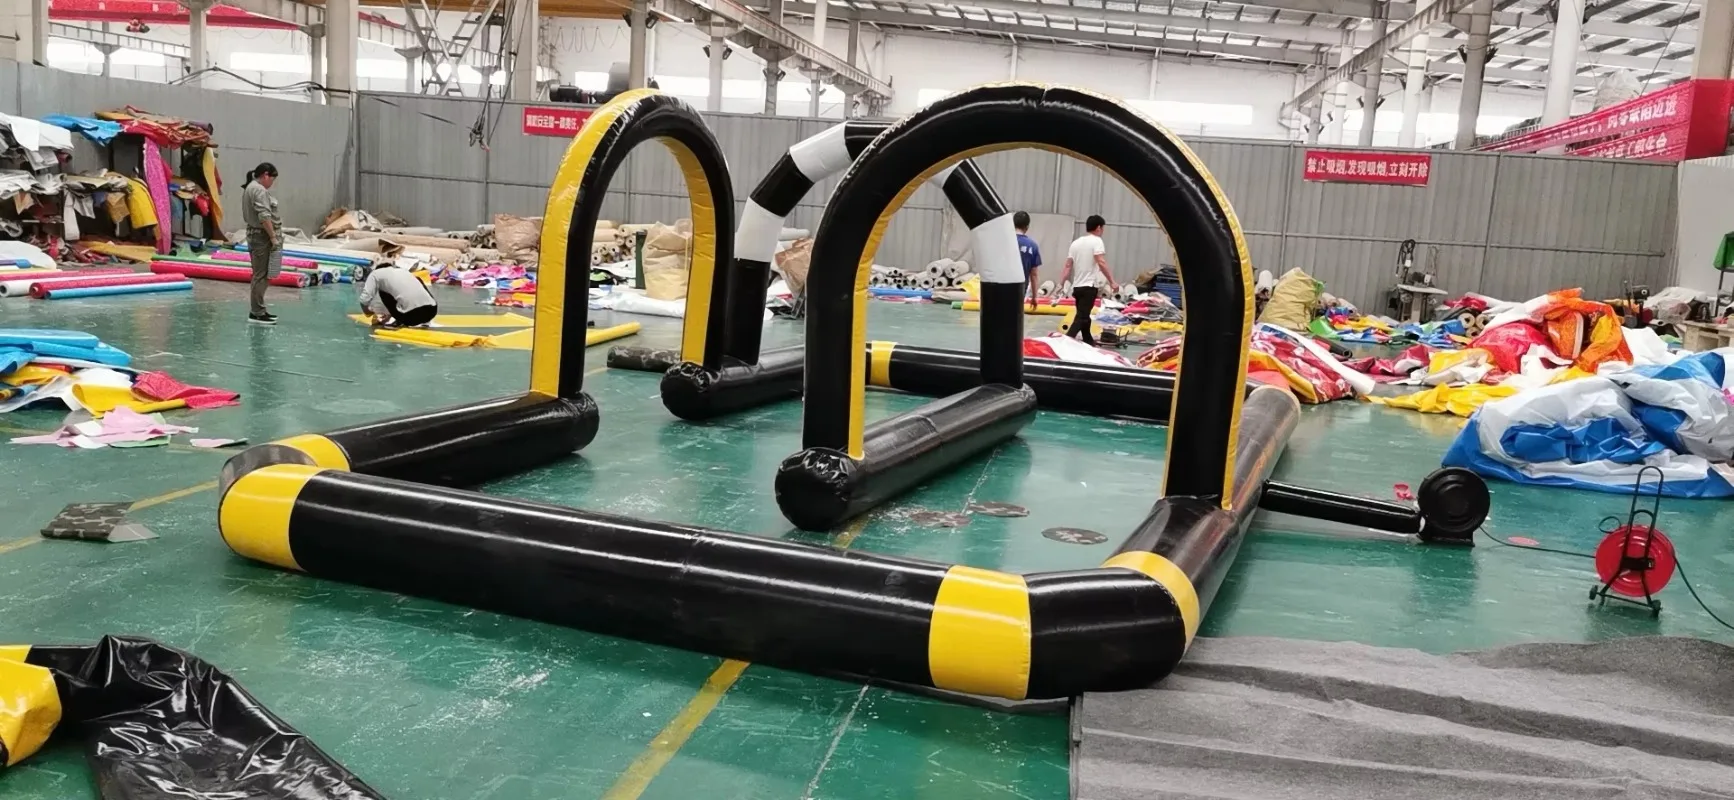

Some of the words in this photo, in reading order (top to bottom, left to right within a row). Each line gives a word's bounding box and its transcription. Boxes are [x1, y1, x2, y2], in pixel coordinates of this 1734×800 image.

[1307, 157, 1429, 178] 禁止吸烟,发现吸烟,立刻开除
